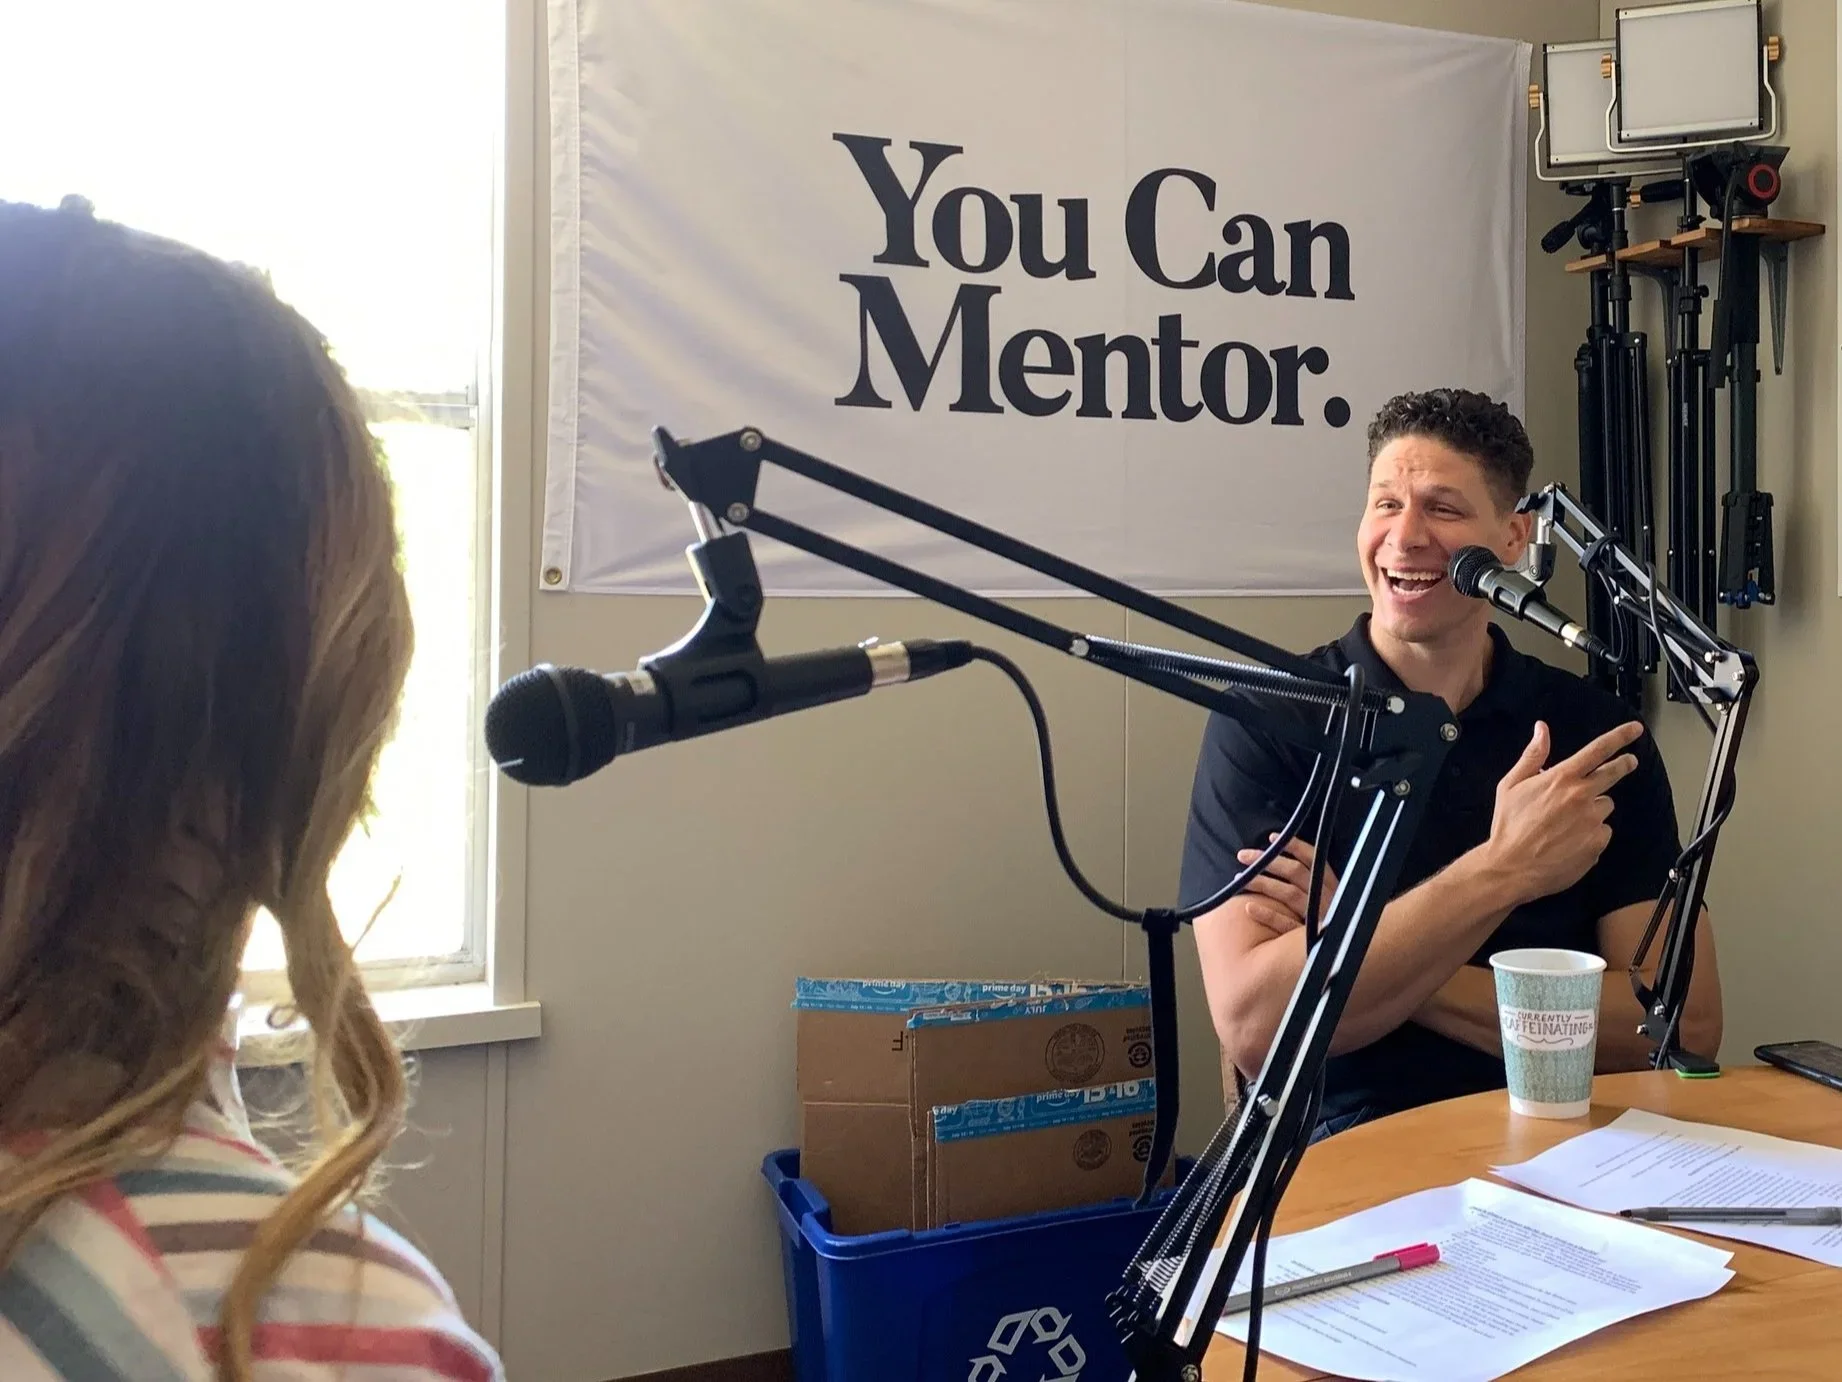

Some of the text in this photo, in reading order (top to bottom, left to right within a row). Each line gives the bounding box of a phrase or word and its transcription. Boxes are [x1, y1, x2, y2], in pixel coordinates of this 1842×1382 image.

[833, 133, 1356, 300] You Can
[834, 273, 1351, 428] Mentor.
[982, 983, 1027, 994] prime day
[1023, 1004, 1047, 1015] JULY
[1517, 1011, 1572, 1023] CURRENTLY
[1036, 1089, 1063, 1104] prime
[940, 1105, 959, 1116] day
